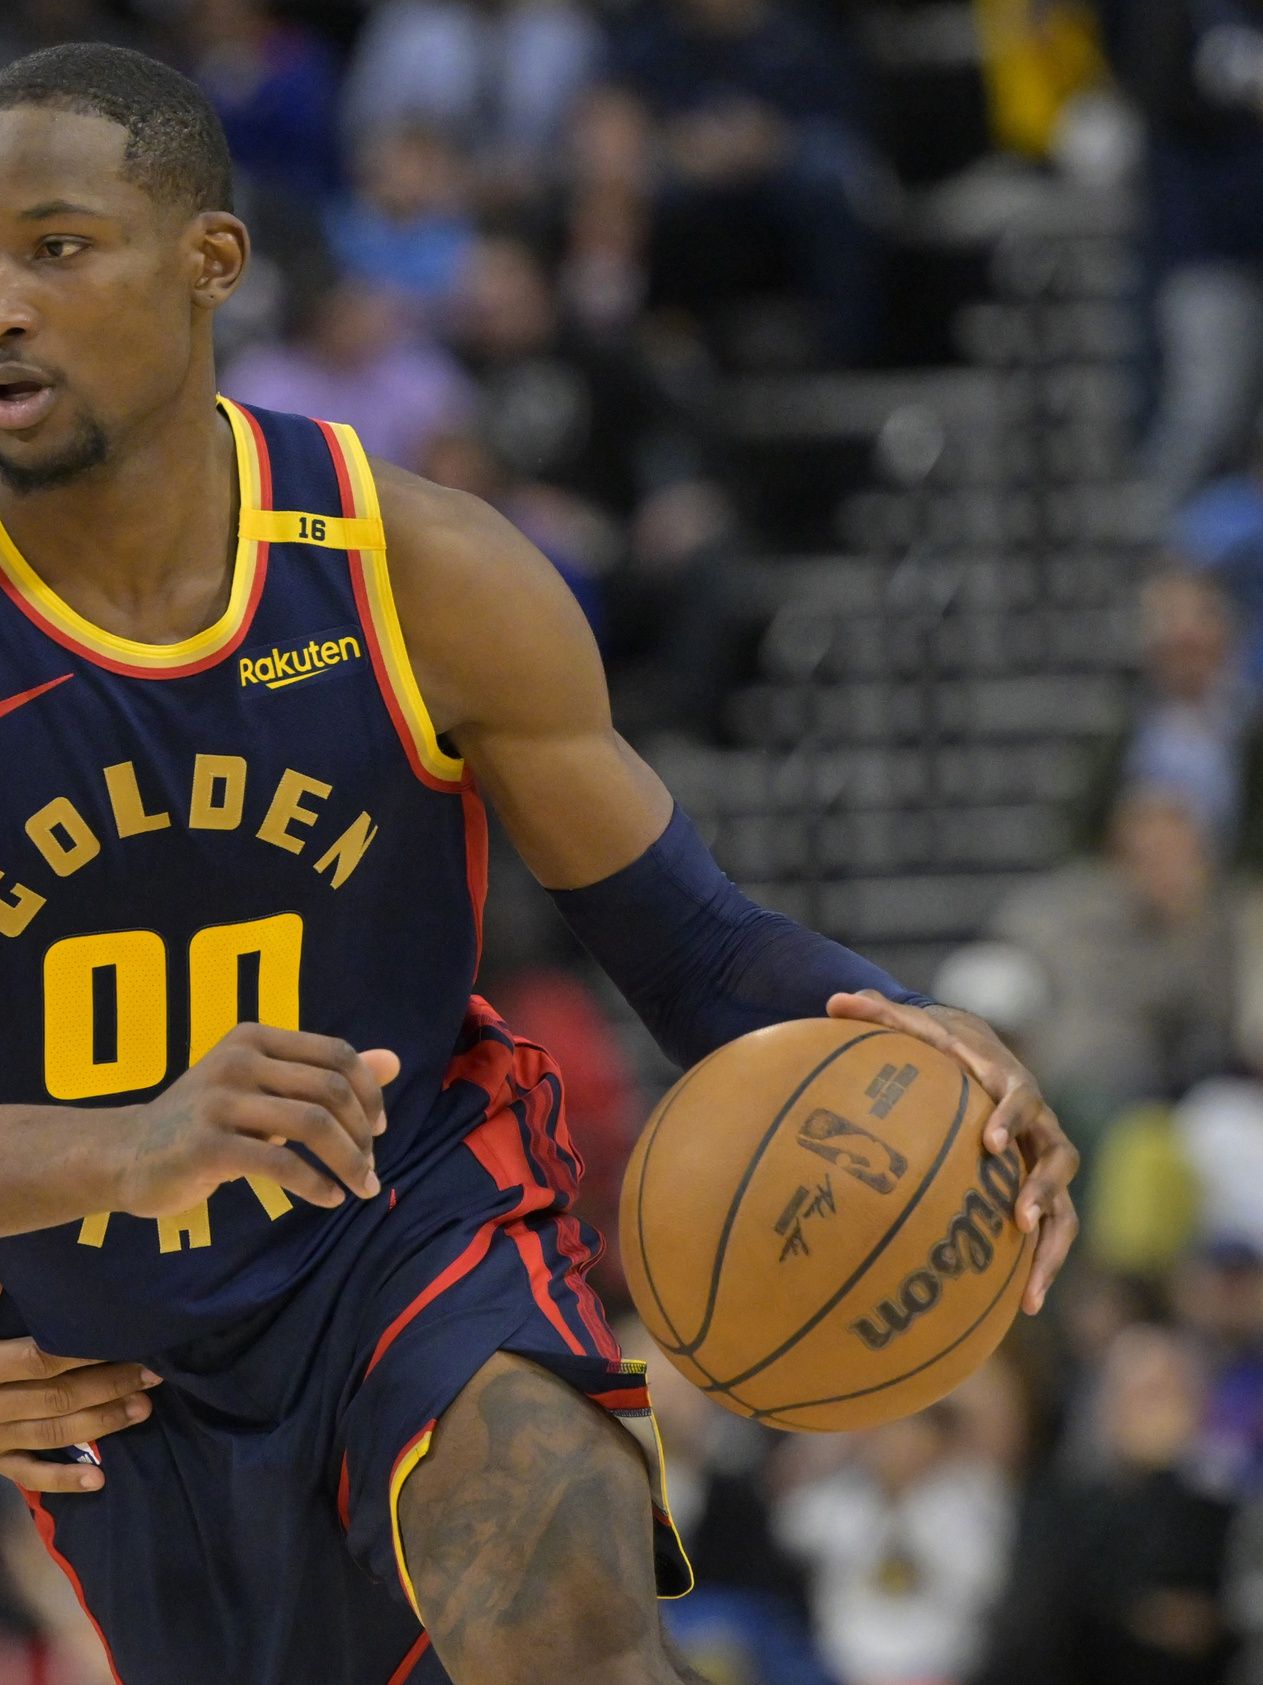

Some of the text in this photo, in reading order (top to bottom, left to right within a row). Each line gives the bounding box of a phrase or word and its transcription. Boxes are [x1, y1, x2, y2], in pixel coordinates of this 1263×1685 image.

[298, 516, 326, 542] 16
[239, 636, 362, 688] Rakuten
[43, 912, 304, 1100] 00
